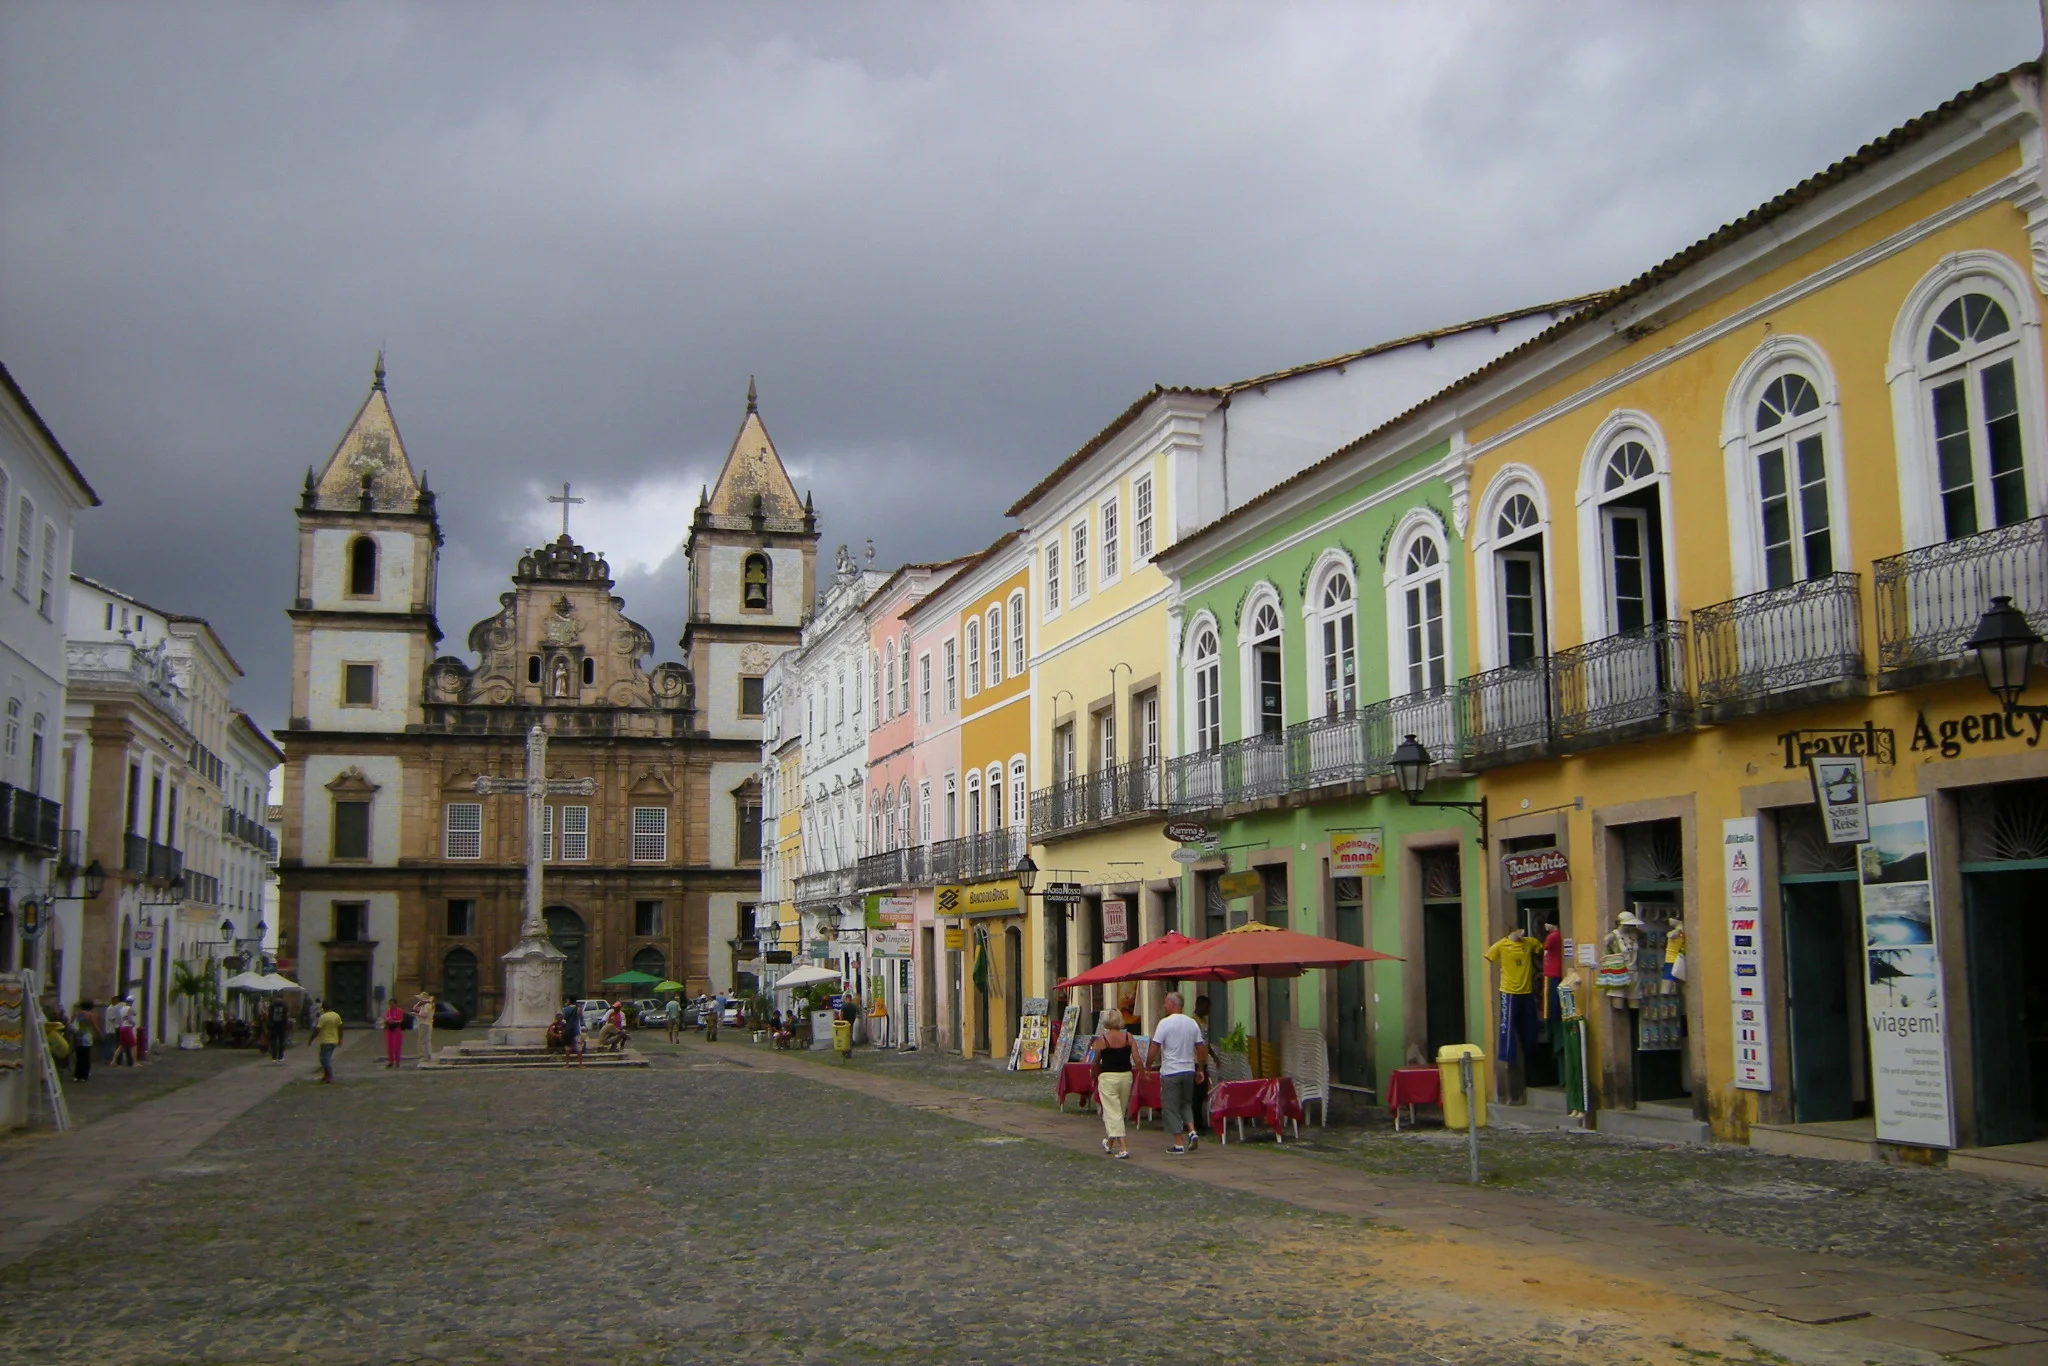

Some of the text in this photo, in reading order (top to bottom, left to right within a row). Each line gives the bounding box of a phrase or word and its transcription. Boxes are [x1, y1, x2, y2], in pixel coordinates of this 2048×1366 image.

[1777, 709, 2047, 769] Travel Agency
[1169, 826, 1198, 836] Ramma
[1832, 818, 1859, 831] Reise
[1725, 833, 1755, 845] Alitalia
[1507, 853, 1568, 877] Bahia Arte
[1731, 920, 1755, 931] TAM
[1872, 1011, 1941, 1038] viagem!
